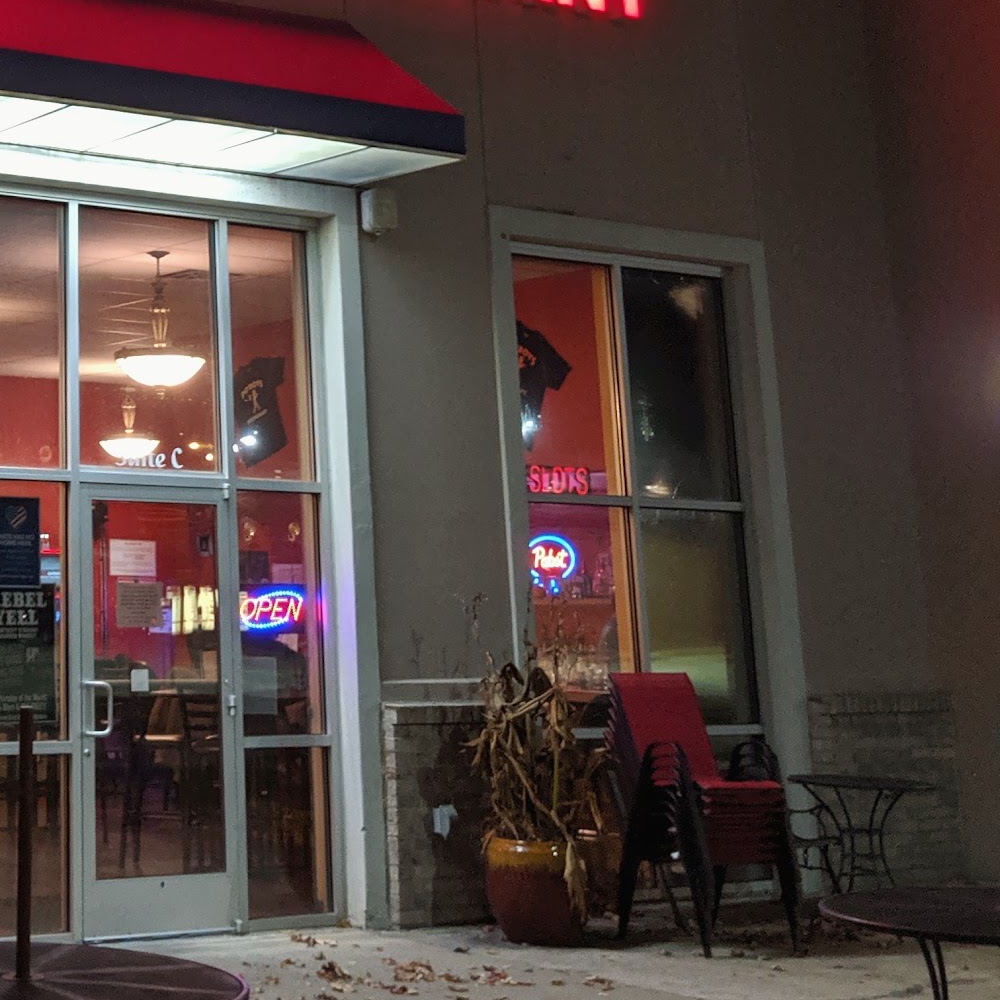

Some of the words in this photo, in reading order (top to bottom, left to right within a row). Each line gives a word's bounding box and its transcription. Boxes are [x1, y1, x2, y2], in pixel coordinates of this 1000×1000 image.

[170, 447, 183, 469] C
[529, 465, 589, 495] SLOTS
[240, 597, 303, 621] OPEN
